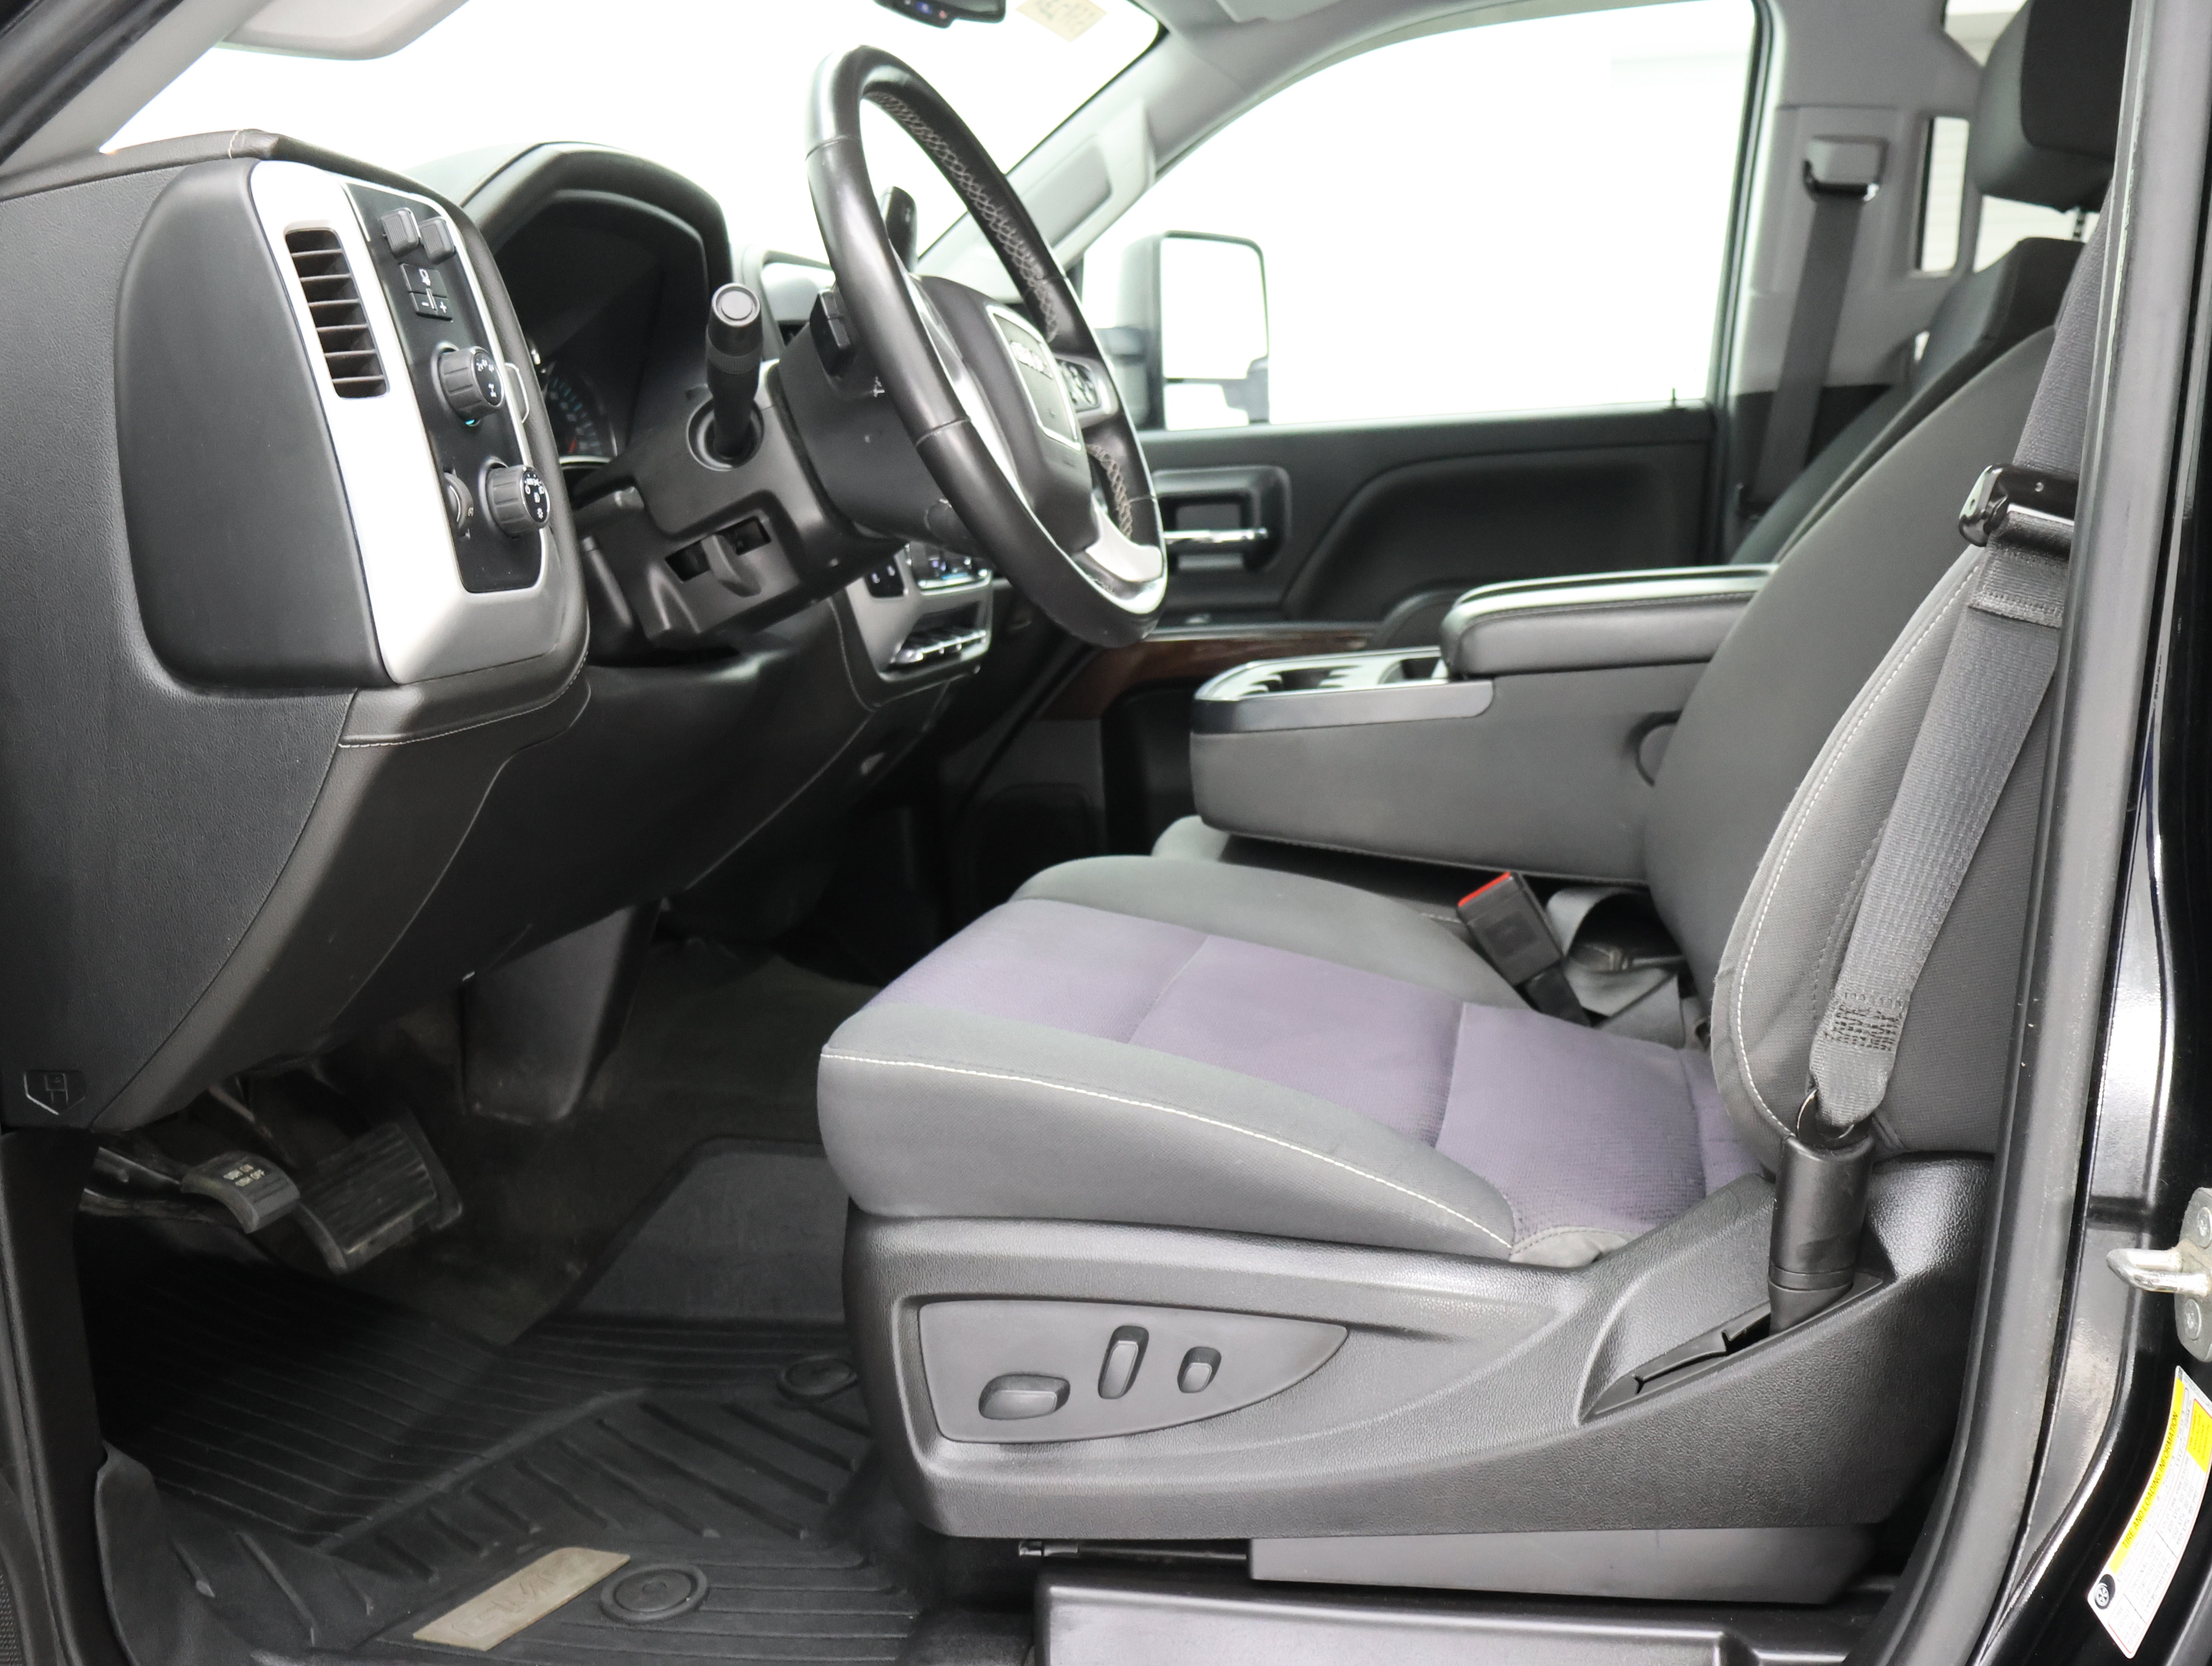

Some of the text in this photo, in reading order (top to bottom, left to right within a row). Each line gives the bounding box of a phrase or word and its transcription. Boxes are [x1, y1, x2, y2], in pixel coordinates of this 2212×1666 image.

[2123, 1411, 2177, 1548] TIRE AND LOADING INFORMATION
